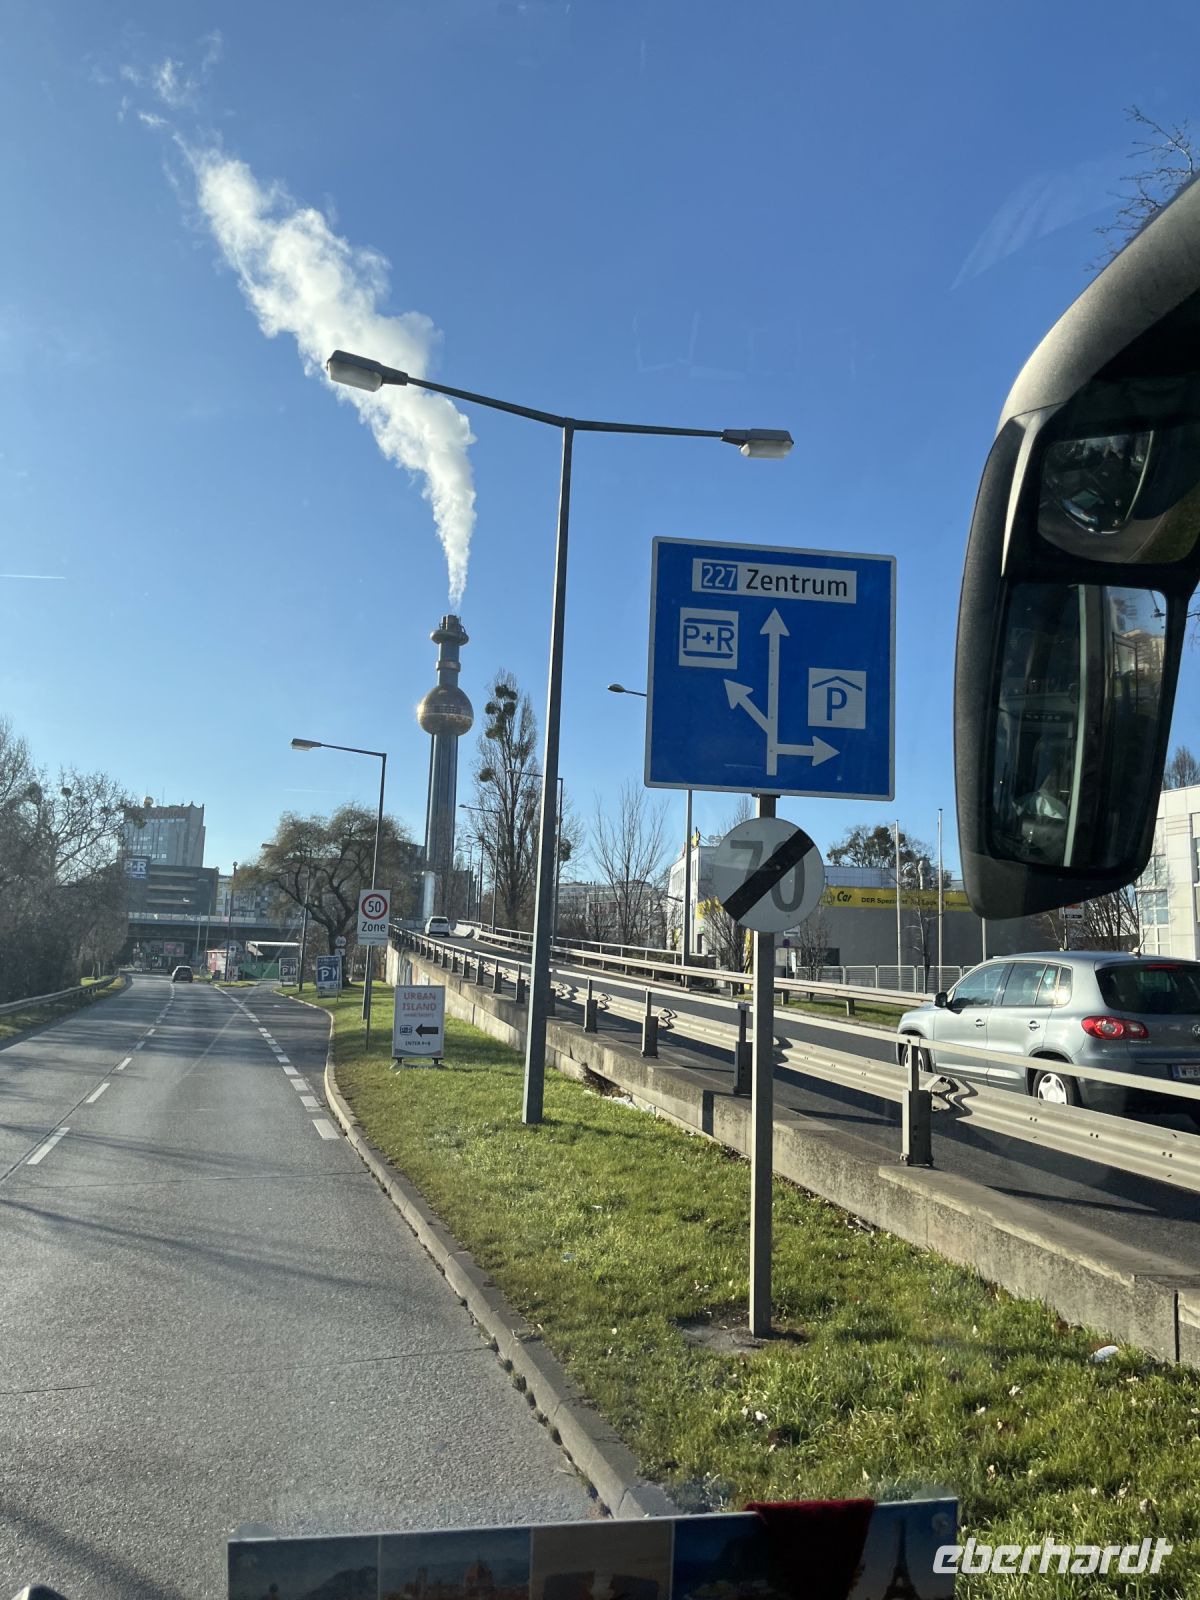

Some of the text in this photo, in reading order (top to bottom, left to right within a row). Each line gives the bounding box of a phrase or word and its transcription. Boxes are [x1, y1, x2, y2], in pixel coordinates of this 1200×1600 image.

[702, 565, 848, 597] 227 Zentrum
[682, 624, 735, 652] P+R
[826, 686, 848, 721] P
[729, 839, 805, 913] 70
[836, 890, 852, 903] Car
[367, 900, 382, 913] 50
[361, 921, 386, 932] Zone
[321, 969, 330, 981] P
[403, 992, 436, 1001] URBAN
[402, 1002, 437, 1011] ISLAND
